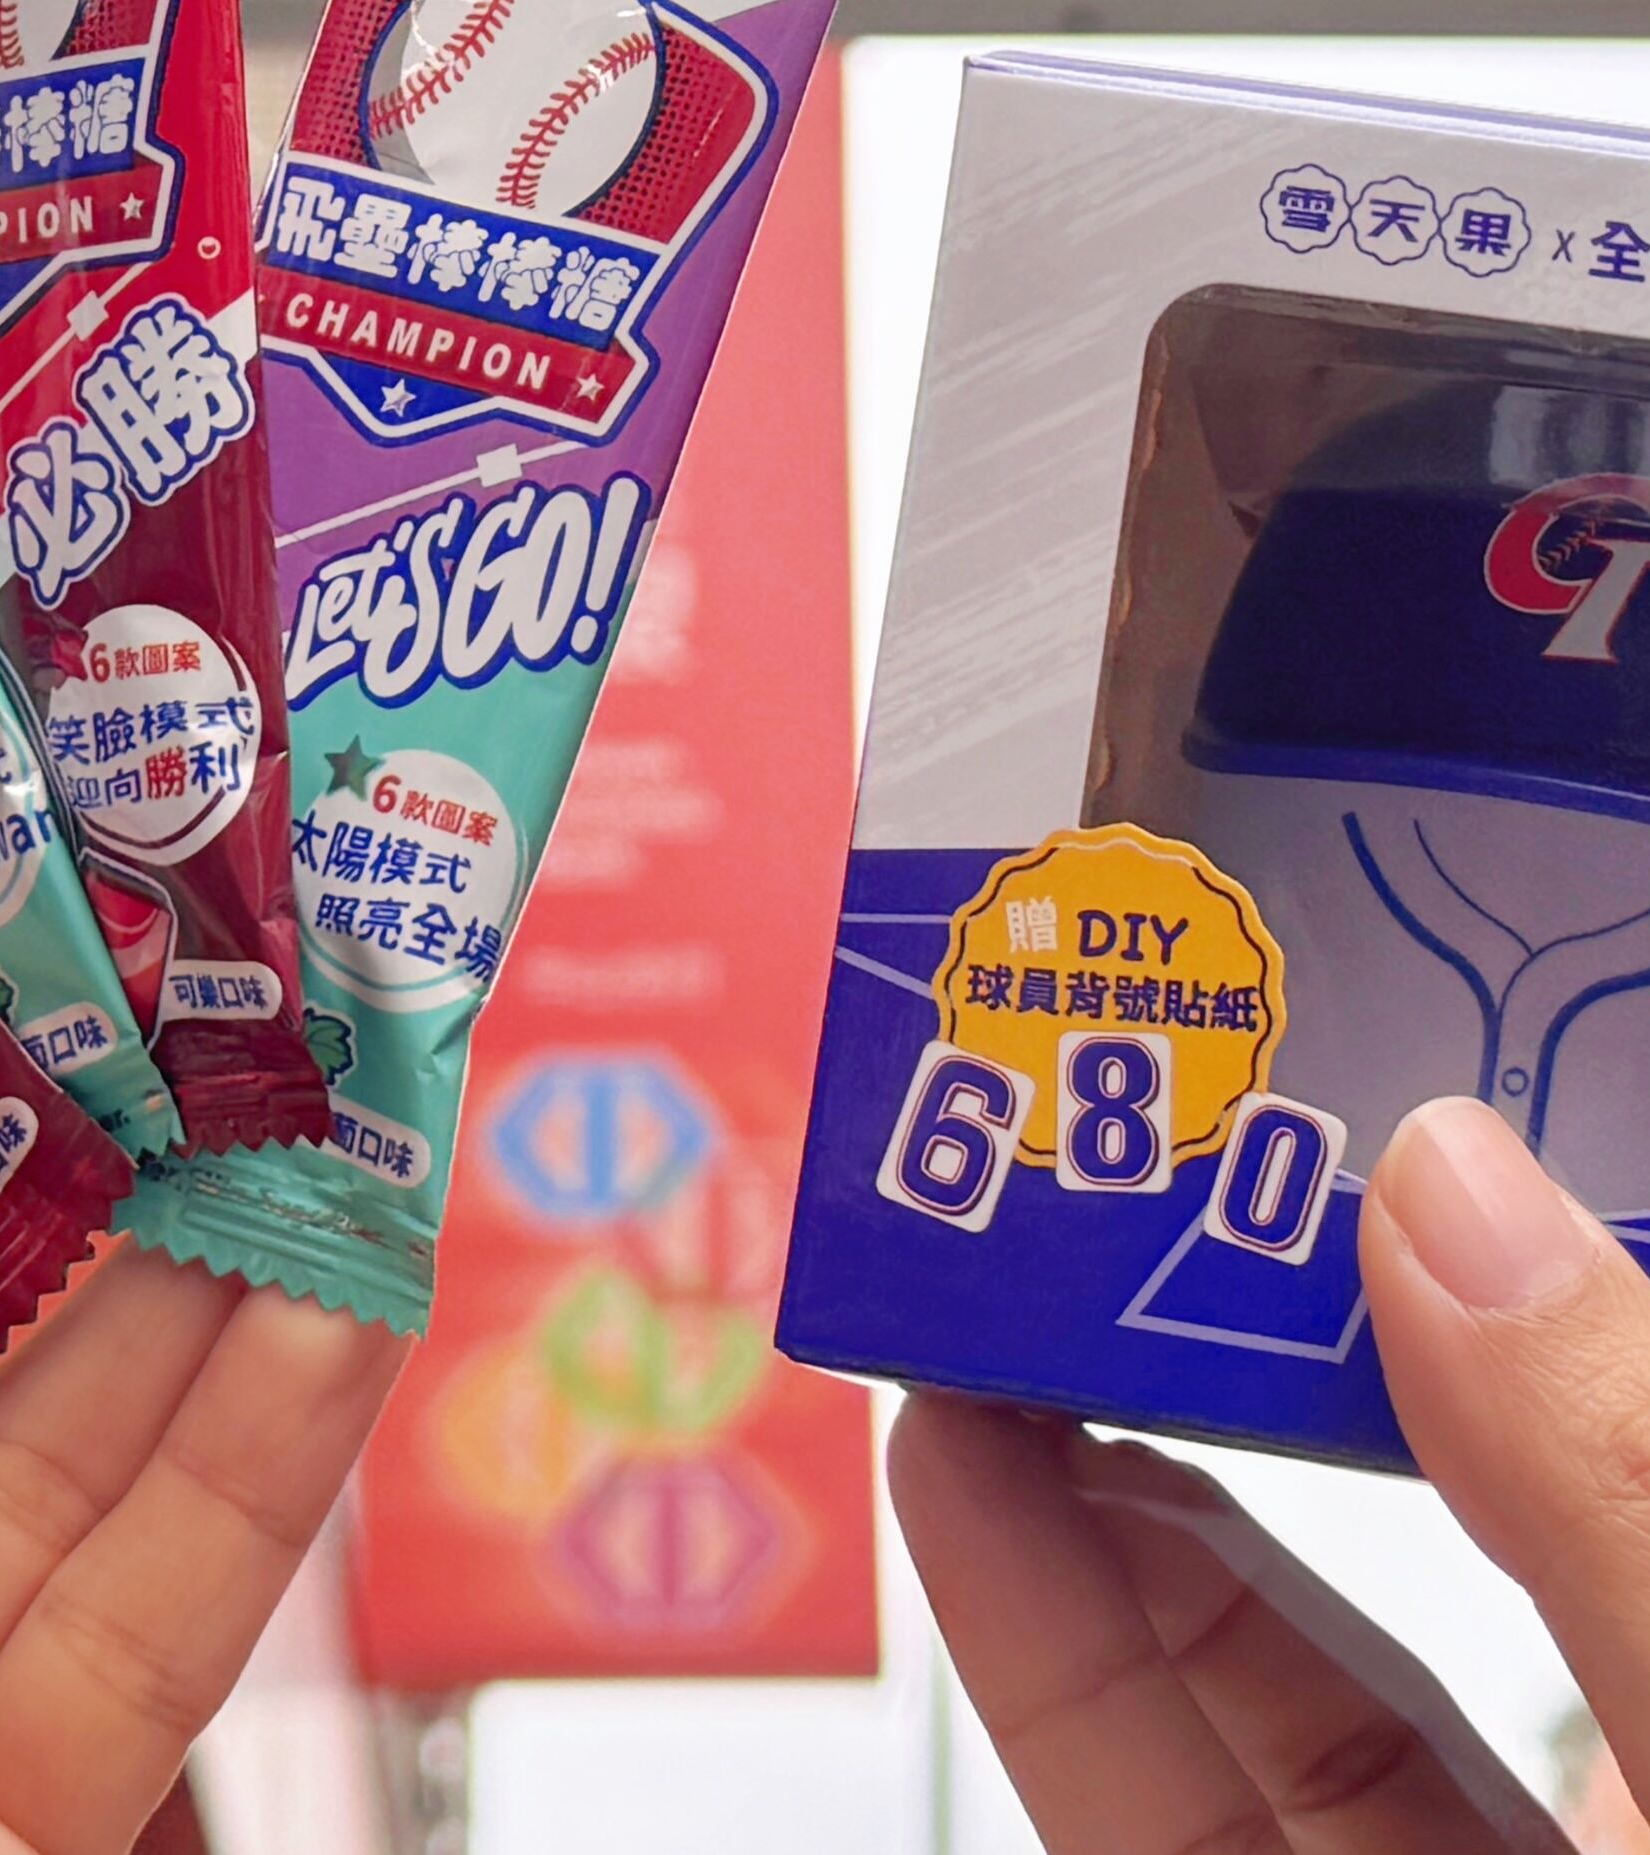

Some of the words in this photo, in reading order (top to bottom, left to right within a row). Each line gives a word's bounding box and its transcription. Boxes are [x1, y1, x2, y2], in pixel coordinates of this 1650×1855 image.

[274, 178, 642, 332] 飛壘棒棒糖
[1278, 184, 1514, 258] 雪天果
[286, 291, 552, 392] CHAMPION
[7, 294, 254, 609] 必勝
[89, 640, 202, 684] 6款圖案
[48, 695, 256, 766] 笑臉模式
[67, 740, 241, 809] 迎向勝利
[372, 774, 498, 847] 6款圖案
[291, 808, 473, 894] 太陽模式
[314, 892, 503, 983] 照亮全場
[1004, 895, 1059, 954] 贈
[1076, 908, 1190, 966] DIY
[964, 962, 1259, 1033] 球員背號貼紙
[895, 1053, 1018, 1218] 6
[1065, 1034, 1162, 1187] 8
